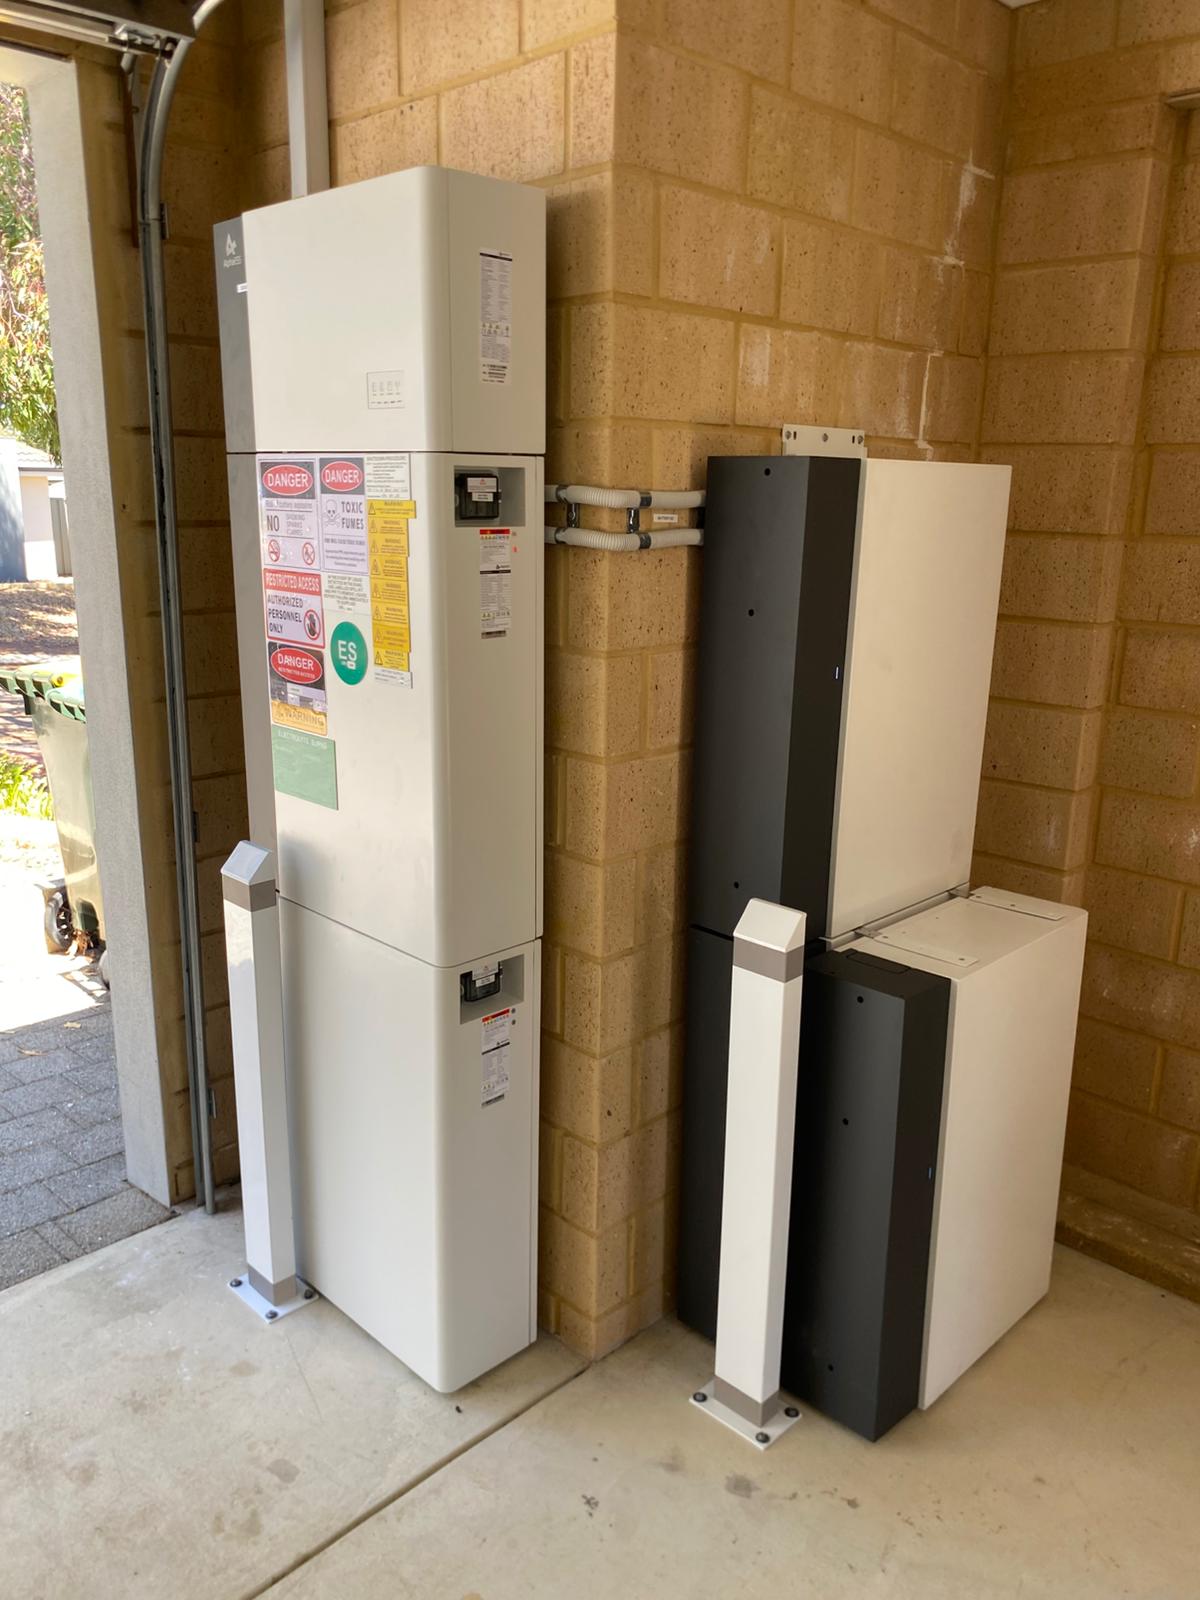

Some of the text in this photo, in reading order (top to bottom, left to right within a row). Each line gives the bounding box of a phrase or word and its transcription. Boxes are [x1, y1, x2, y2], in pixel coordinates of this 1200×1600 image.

[267, 473, 309, 488] DANGER
[325, 469, 360, 484] DANGER
[341, 501, 363, 514] TOXIC
[266, 515, 280, 532] NO
[341, 517, 364, 531] FUMES
[265, 572, 298, 589] RESTRICTED
[298, 576, 320, 592] ACCESS
[267, 594, 304, 608] AUTHORIZED
[268, 608, 302, 623] PERSONNEL
[269, 622, 283, 634] ONLY
[277, 653, 314, 671] DANGER
